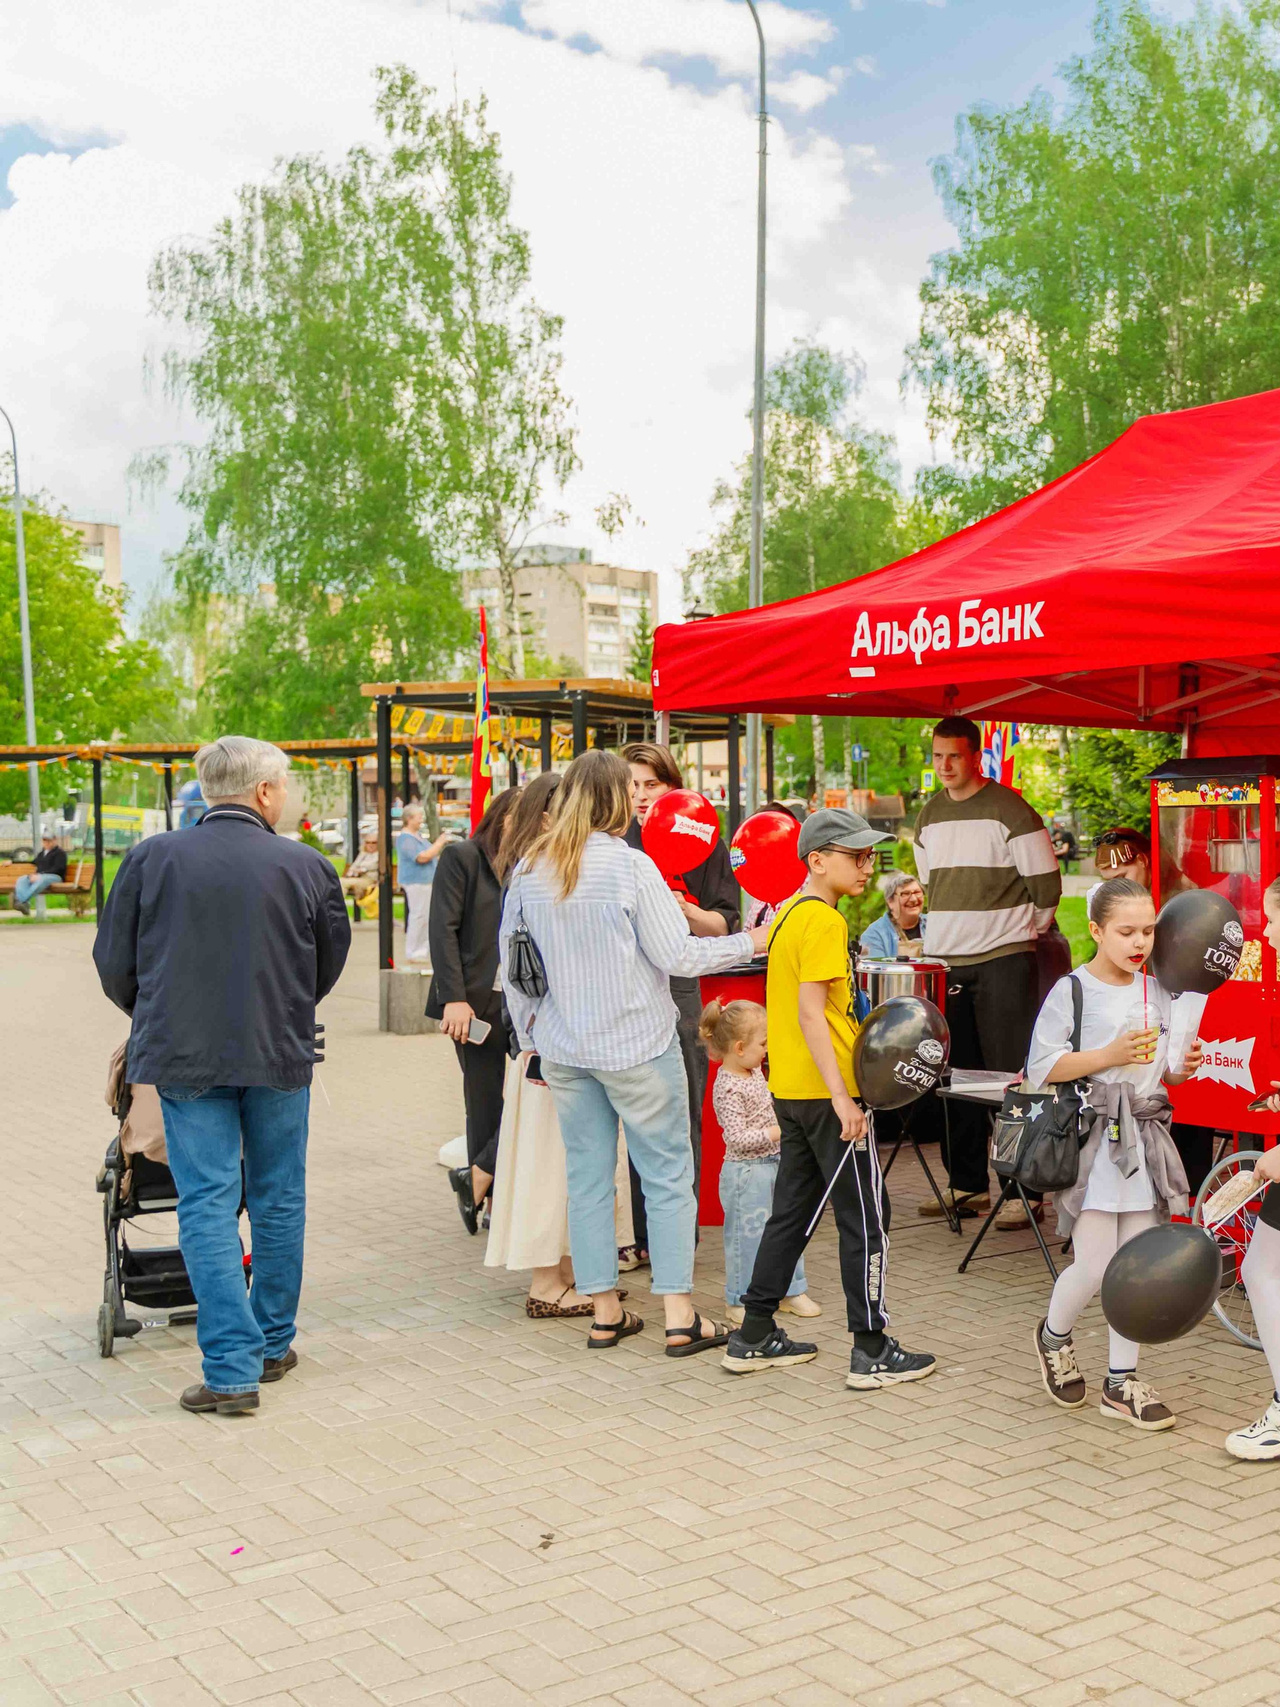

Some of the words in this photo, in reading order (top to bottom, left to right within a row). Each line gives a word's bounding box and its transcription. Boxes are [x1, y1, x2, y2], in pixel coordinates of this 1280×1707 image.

[851, 606, 951, 665] Альфа
[957, 598, 1045, 649] Банк
[893, 1060, 937, 1088] ГОРКИ
[1214, 1051, 1244, 1069] Банк
